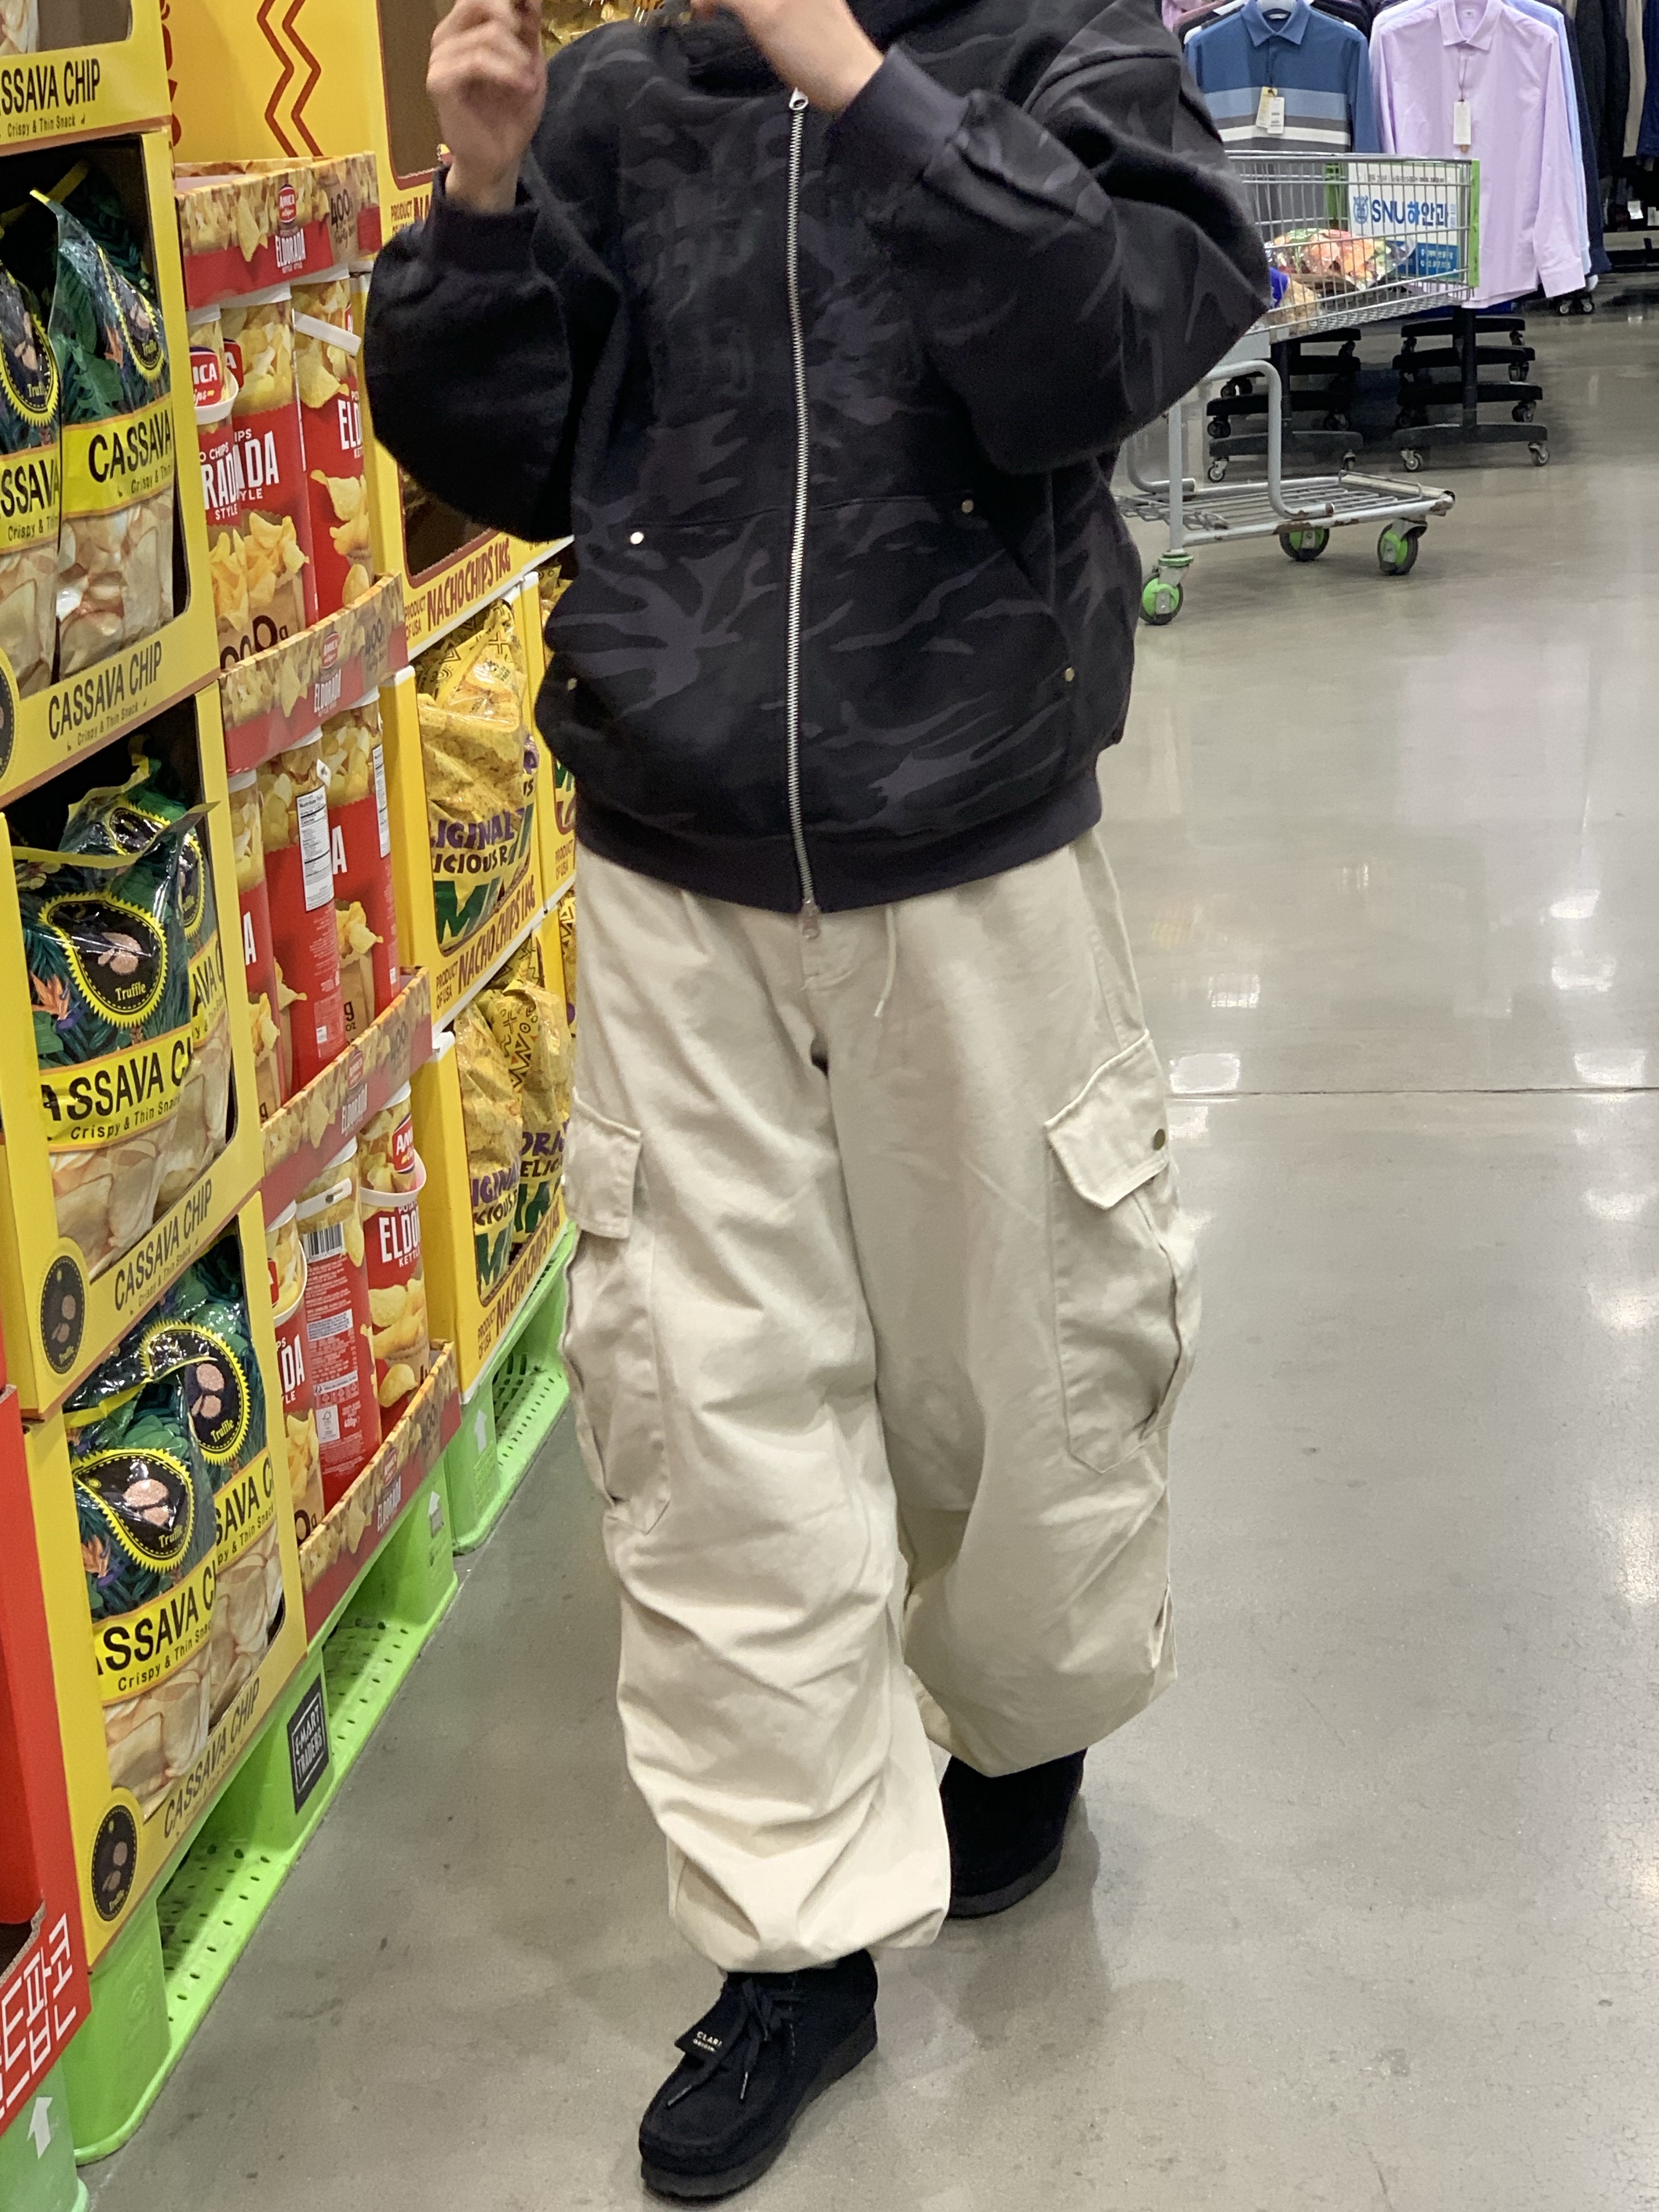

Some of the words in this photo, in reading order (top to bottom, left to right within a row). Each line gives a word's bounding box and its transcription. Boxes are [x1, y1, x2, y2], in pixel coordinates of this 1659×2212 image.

[0, 65, 59, 116] SSAVA
[64, 58, 100, 106] CHIP
[8, 122, 30, 137] Crispy
[32, 120, 37, 133] &
[40, 117, 54, 132] Thin
[56, 114, 76, 129] Snack
[88, 410, 172, 483] CASSAVA
[8, 523, 35, 542] Crispy
[38, 518, 43, 533] &
[215, 504, 238, 521] STYLE
[49, 664, 125, 740] CASSAVA
[129, 640, 162, 696] CHIP
[431, 806, 525, 850] IGINAL
[115, 981, 146, 1002] Truffle
[71, 1123, 121, 1140] Crispy
[124, 1116, 130, 1130] &
[135, 1105, 154, 1126] Thin
[115, 1216, 179, 1311] CASSAVA
[183, 1178, 212, 1240] CHIP
[210, 1418, 235, 1443] Truffle
[239, 1526, 256, 1546] Thin
[118, 1662, 161, 1691] Crispy
[165, 1655, 171, 1669] &
[174, 1640, 193, 1661] Thin
[164, 1726, 227, 1839] CASSAVA
[230, 1677, 259, 1744] CHIP
[0, 1912, 76, 2120] 트팝콘
